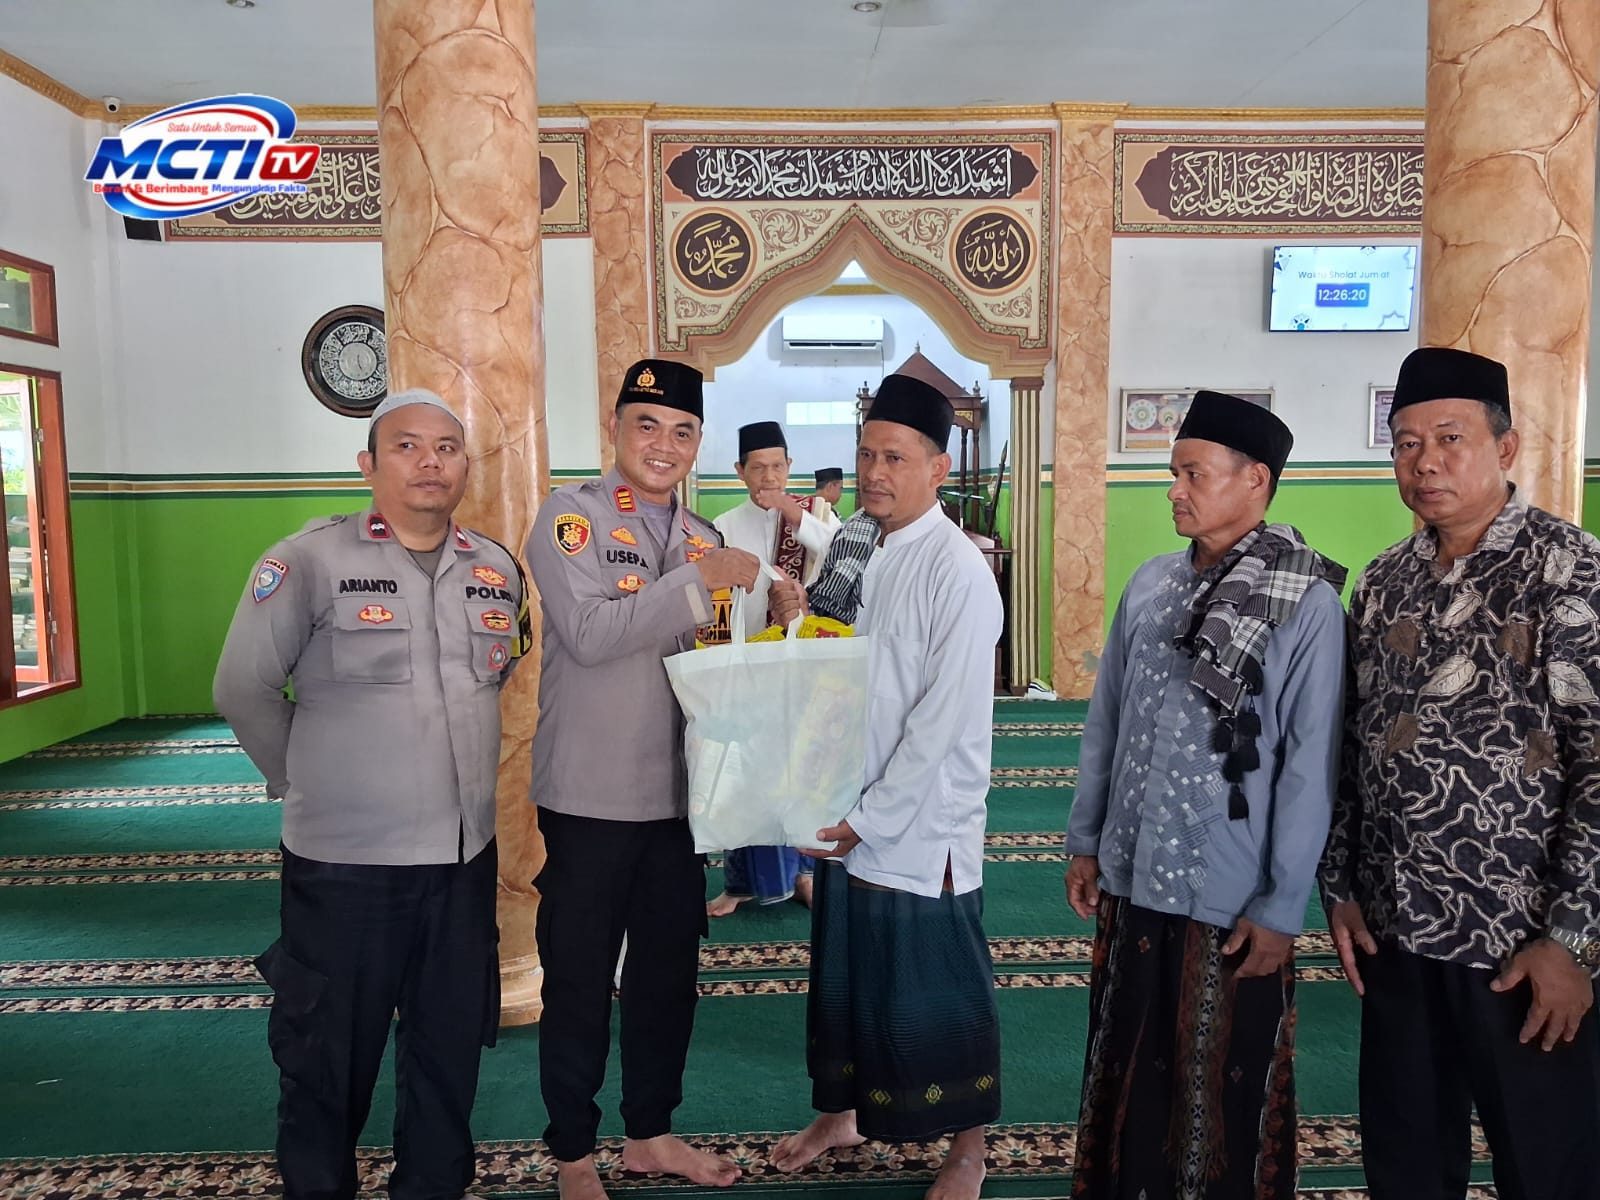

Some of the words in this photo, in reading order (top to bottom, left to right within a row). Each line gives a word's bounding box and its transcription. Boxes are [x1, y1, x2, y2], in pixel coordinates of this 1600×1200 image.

[1329, 271, 1357, 279] Sholat
[1318, 289, 1367, 301] 12:26:20
[339, 579, 397, 594] ARIANTO
